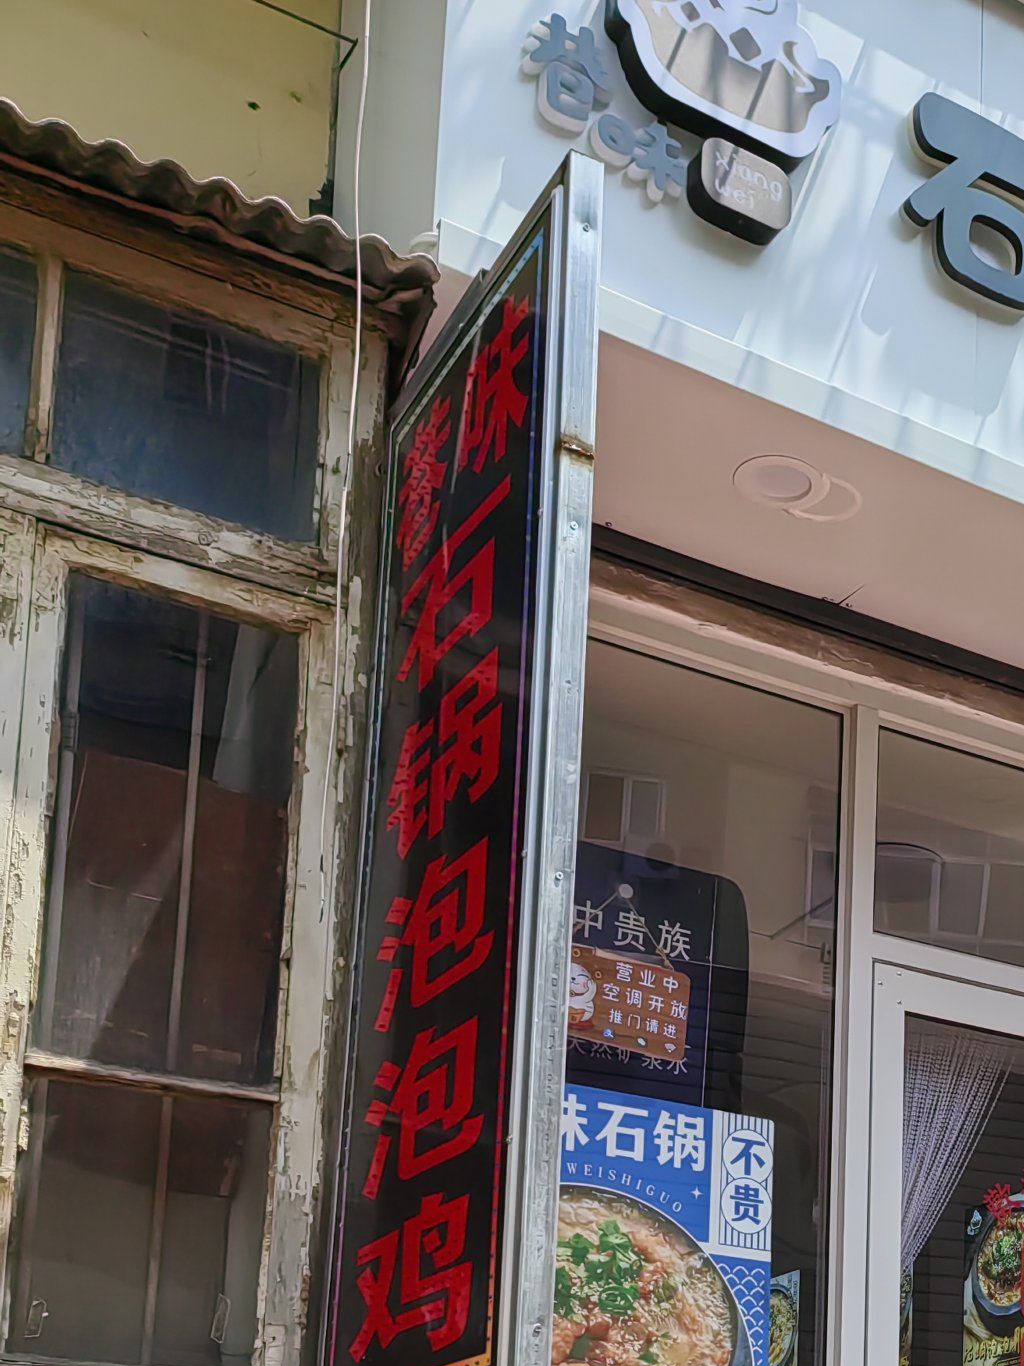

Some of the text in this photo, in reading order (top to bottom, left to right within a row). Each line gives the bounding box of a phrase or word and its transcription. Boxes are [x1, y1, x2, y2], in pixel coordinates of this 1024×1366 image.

[350, 473, 512, 1365] 石锅泡泡鸡
[573, 900, 692, 960] 中贵族
[602, 983, 688, 1021] 空调开放
[615, 962, 680, 994] 营业中
[608, 1008, 678, 1039] 推门请进
[566, 1161, 684, 1214] WEISHIGUO
[729, 1136, 767, 1226] 不贵
